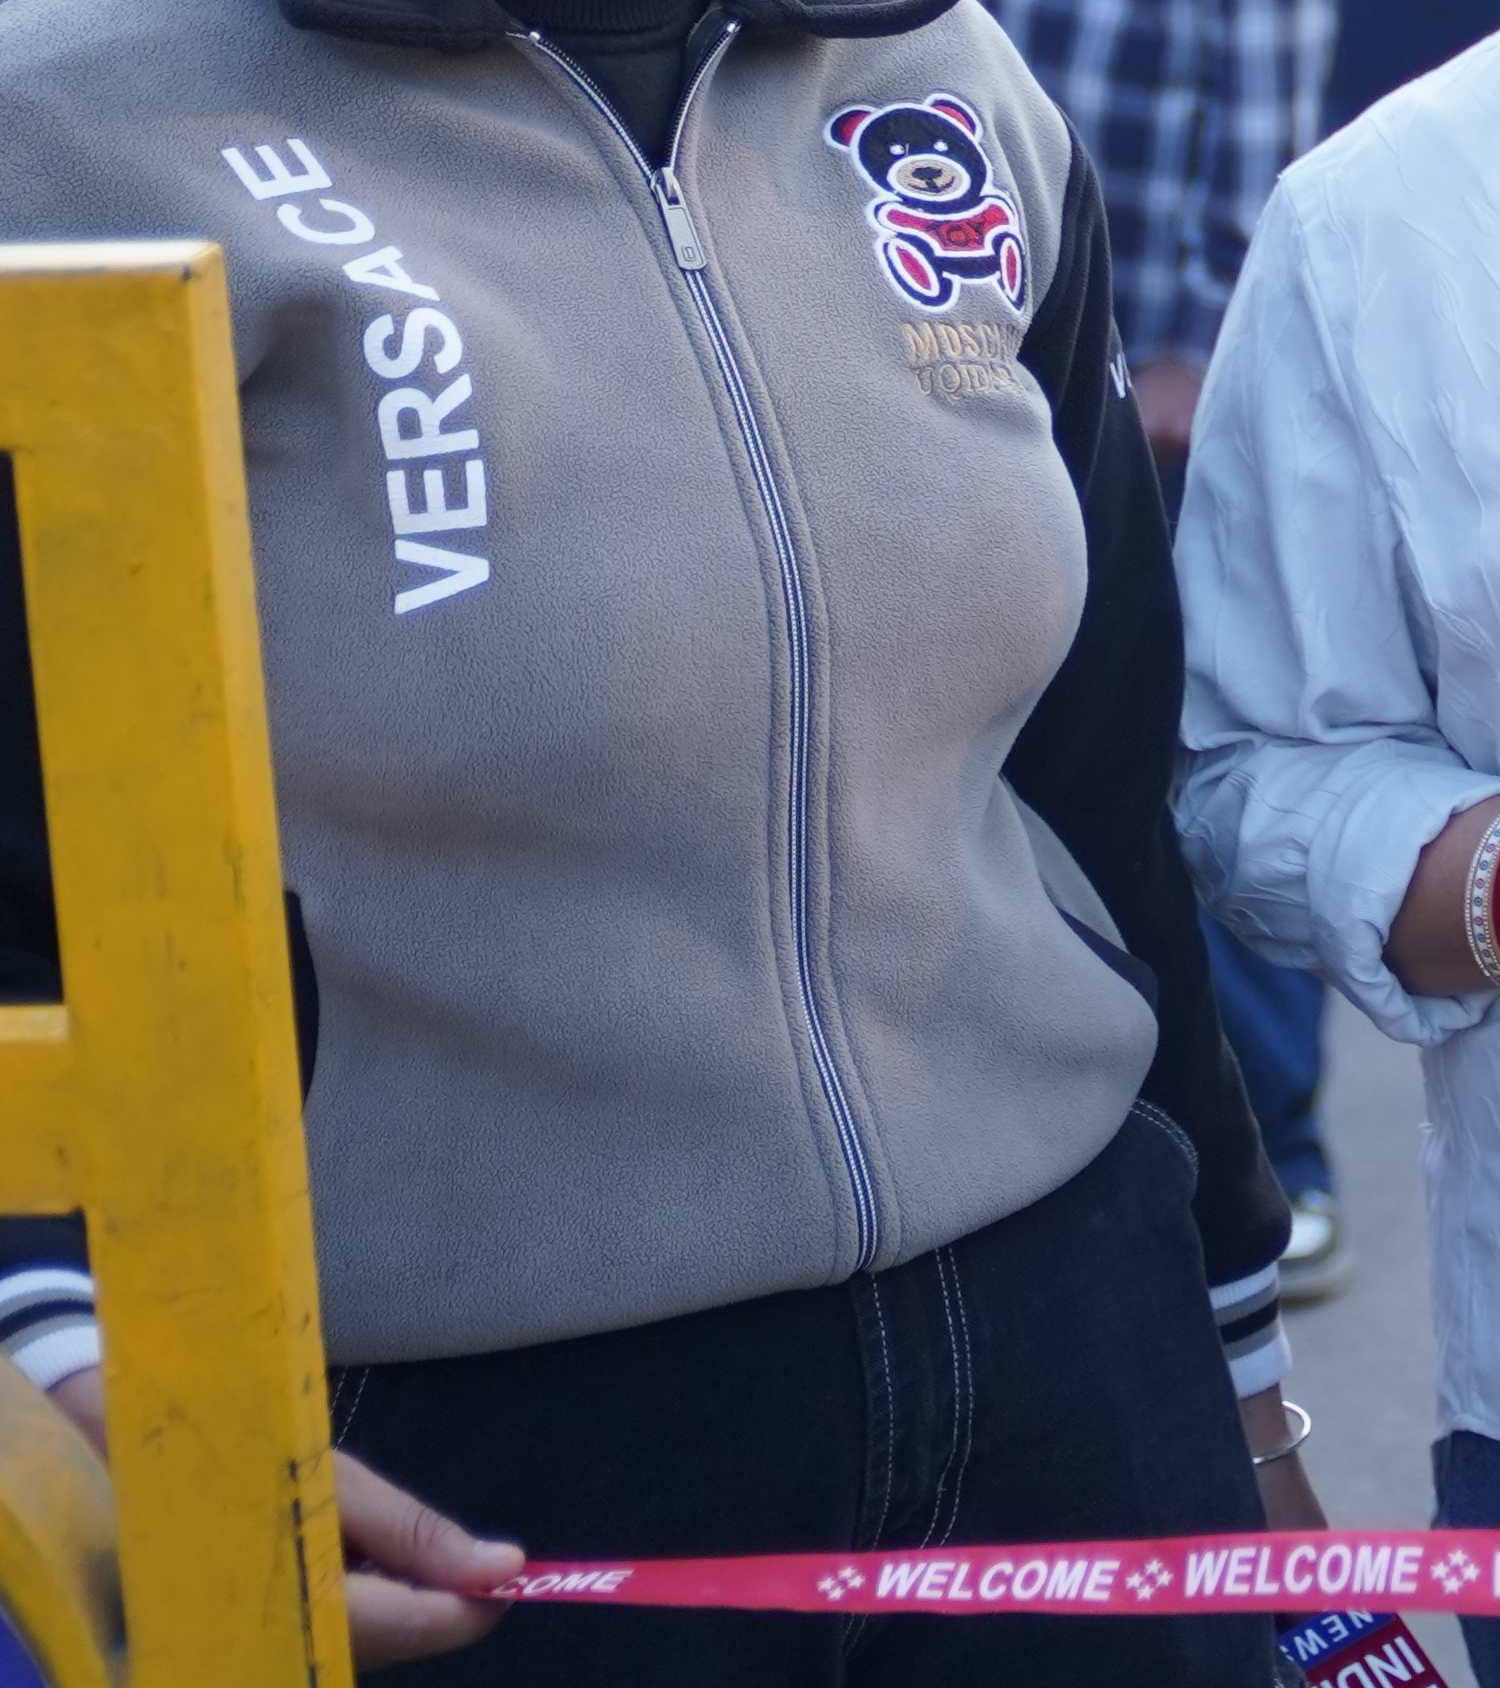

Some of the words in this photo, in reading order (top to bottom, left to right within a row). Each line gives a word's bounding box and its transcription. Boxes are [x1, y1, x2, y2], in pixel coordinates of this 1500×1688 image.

[222, 137, 491, 615] VERSACE
[491, 1567, 635, 1598] COME
[874, 1557, 1122, 1603] WELCOME
[1184, 1542, 1424, 1598] WELCOME
